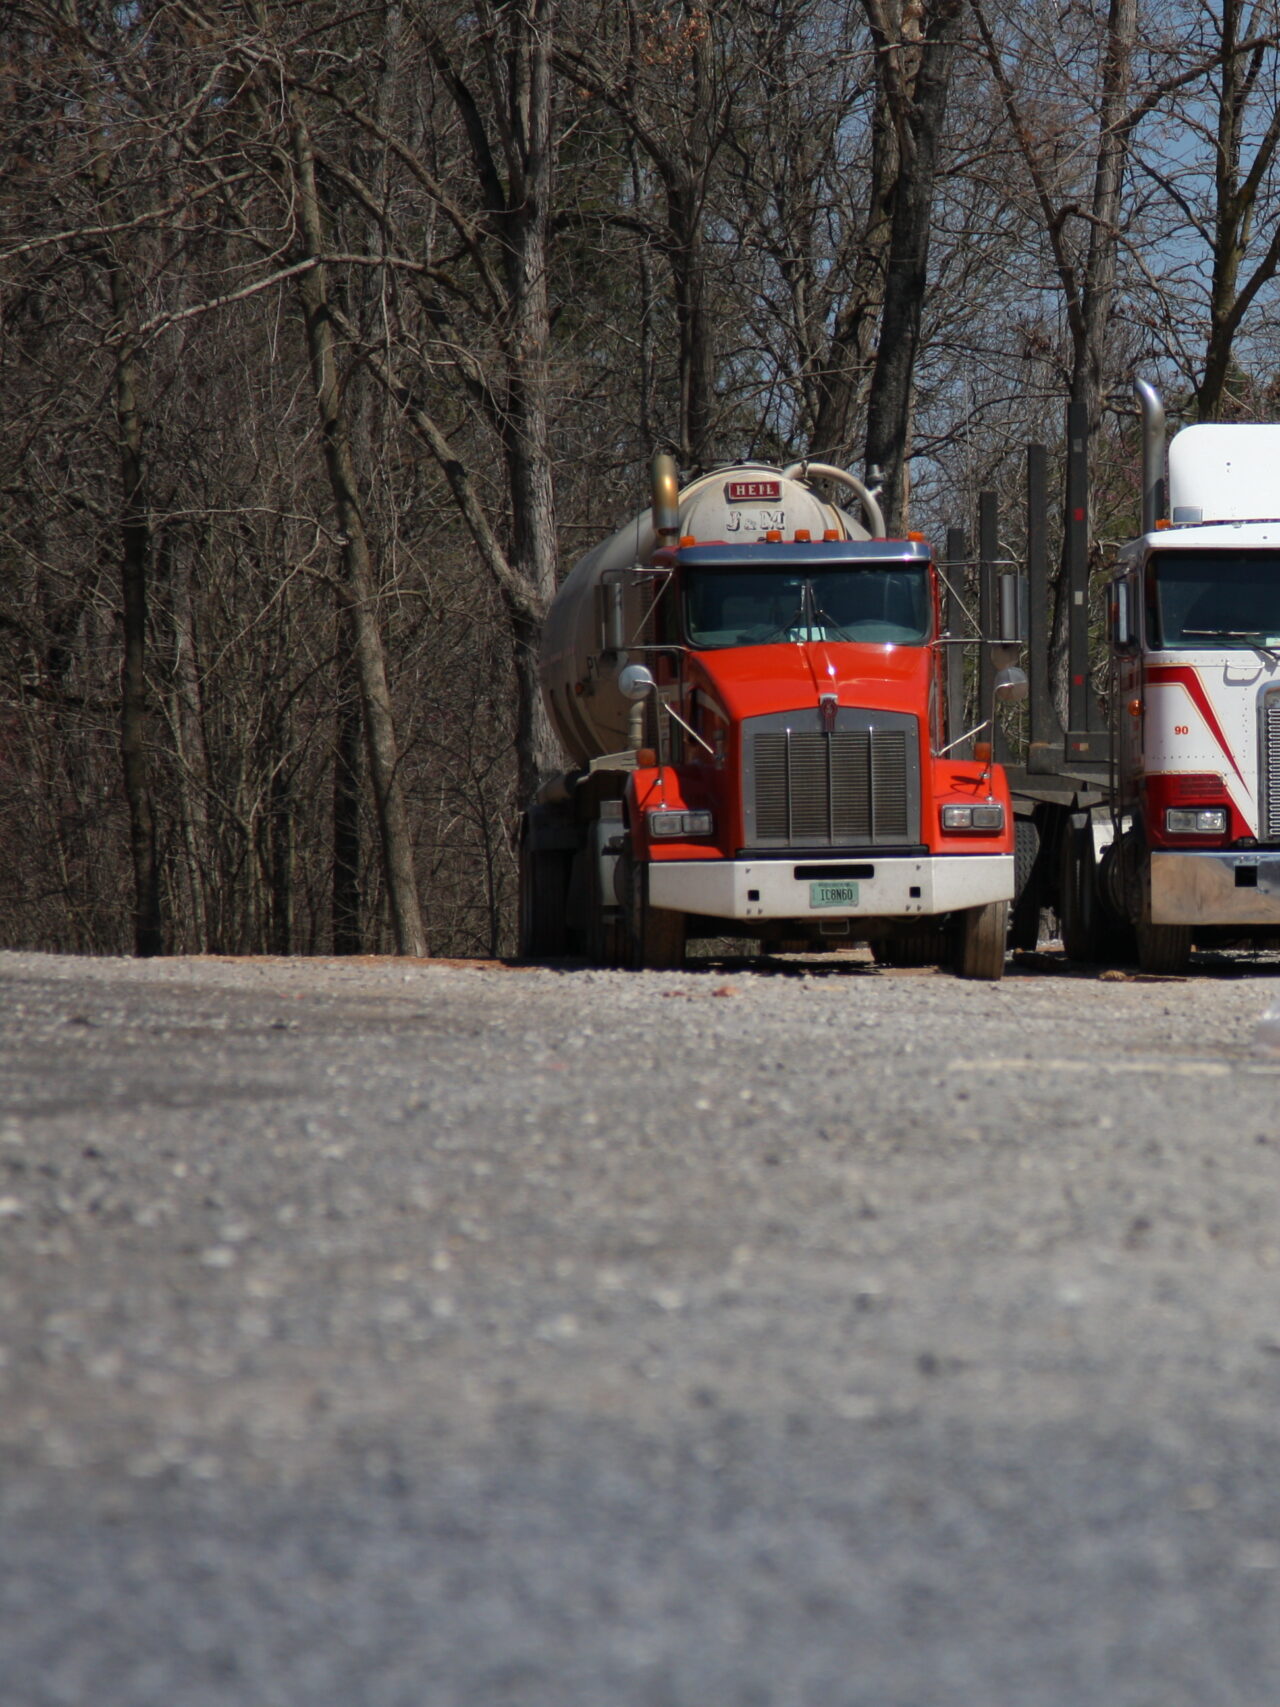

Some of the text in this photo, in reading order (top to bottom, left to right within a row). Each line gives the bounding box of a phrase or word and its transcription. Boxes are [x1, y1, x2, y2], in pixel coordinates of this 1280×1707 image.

[736, 484, 775, 496] HEIL
[726, 511, 742, 531] J
[760, 511, 785, 530] M
[1174, 725, 1189, 735] 90
